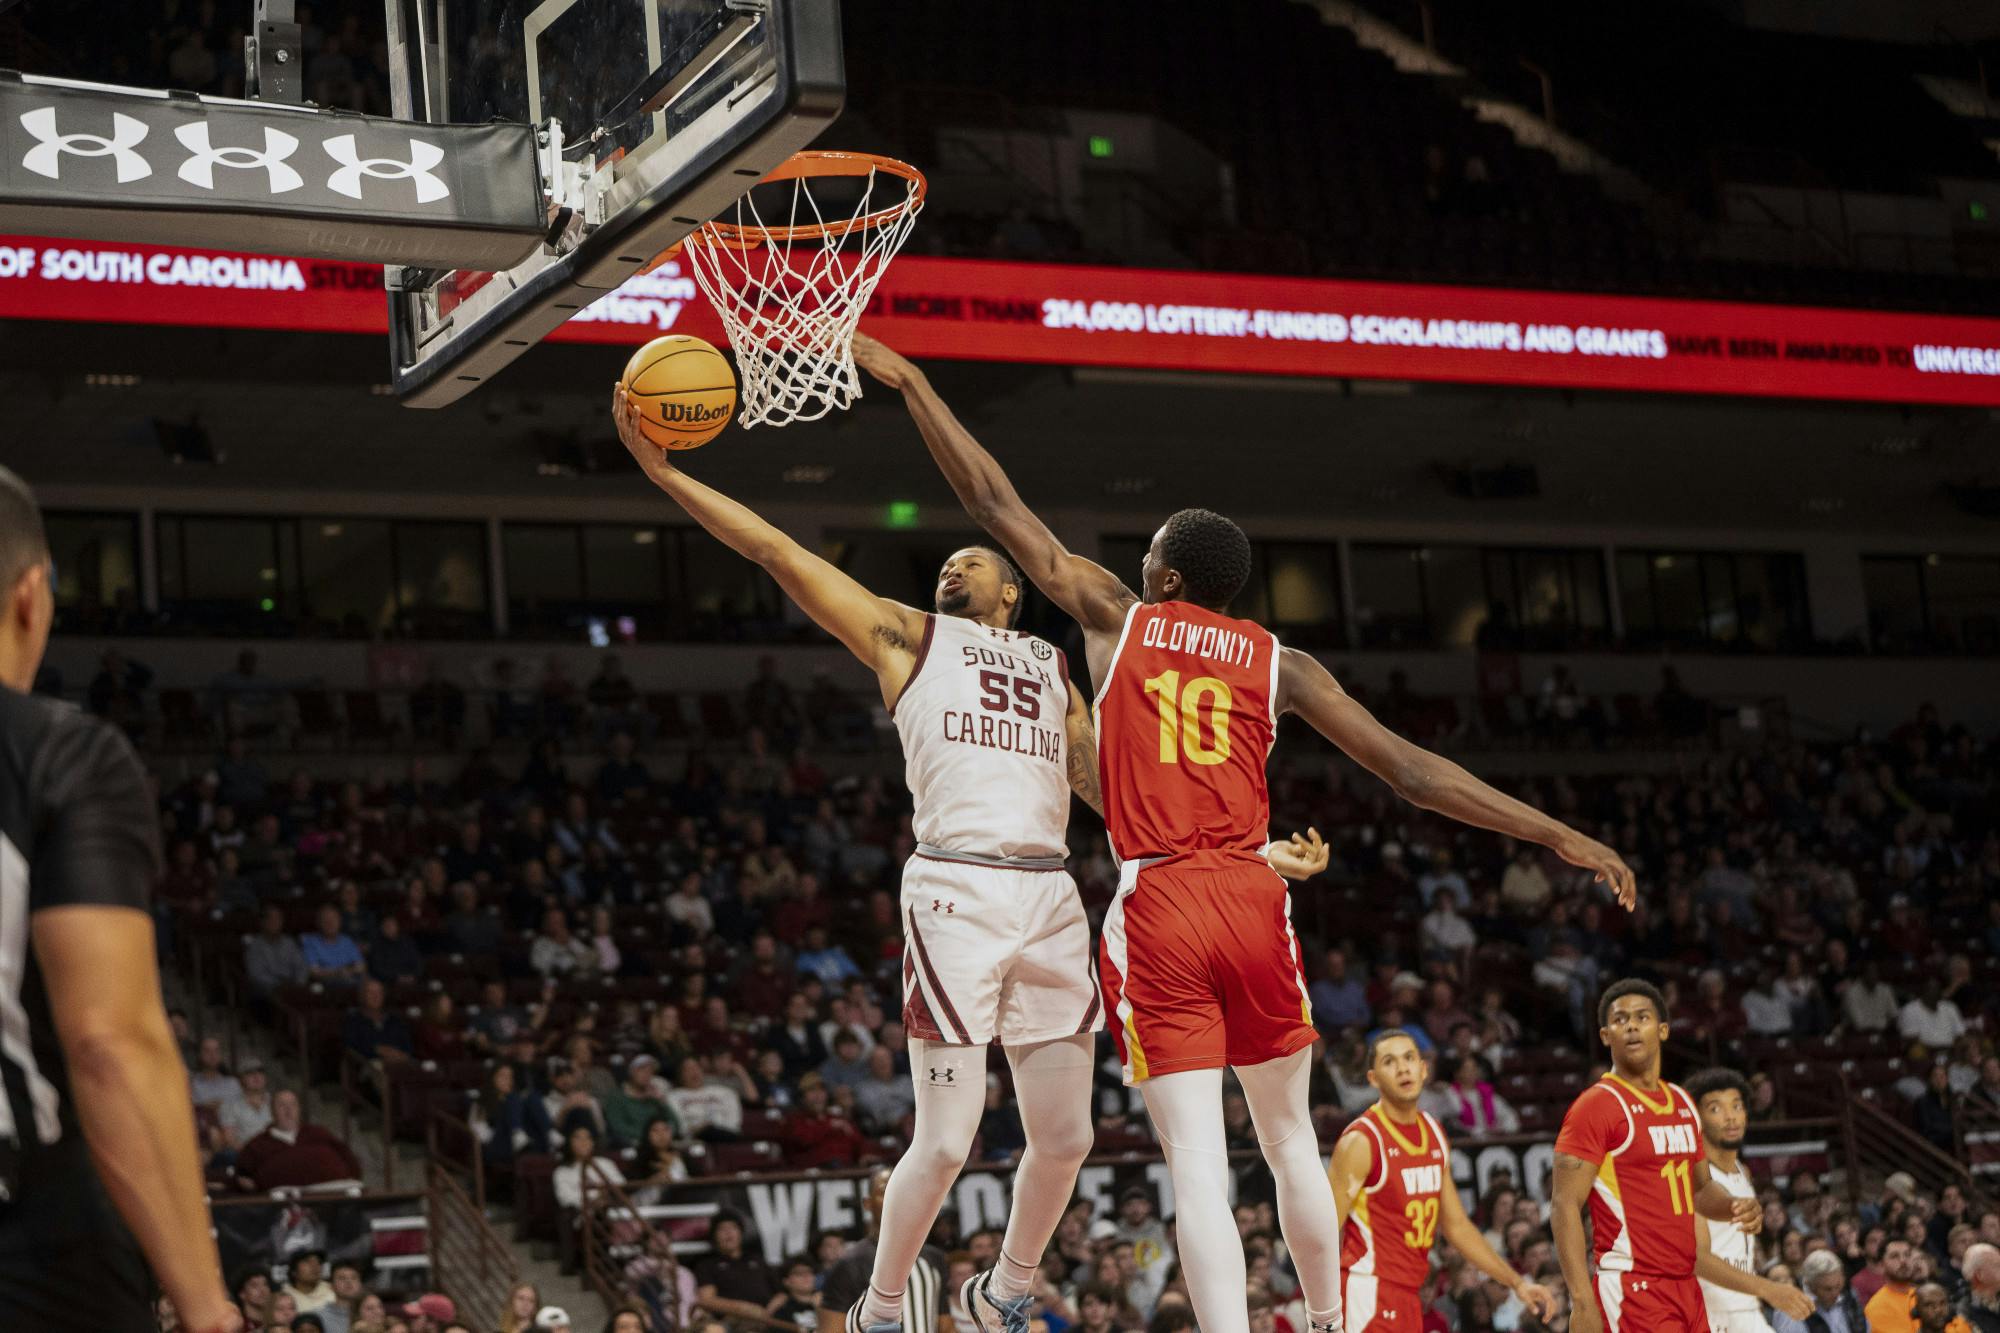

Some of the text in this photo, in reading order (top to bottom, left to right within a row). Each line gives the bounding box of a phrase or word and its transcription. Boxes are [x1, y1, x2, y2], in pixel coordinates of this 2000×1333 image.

[0, 247, 35, 278] OF
[41, 248, 144, 283] SOUTH
[146, 253, 305, 291] CAROLINA
[1144, 304, 1349, 342] LOTTERY-FUNDED
[1350, 314, 1522, 352] SCHOLARSHIPS
[1523, 323, 1574, 354] AND
[1575, 326, 1668, 359] GRANTS
[660, 402, 730, 422] Wilson
[963, 646, 1053, 690] SOUTH
[1031, 641, 1053, 660] SEC
[1143, 617, 1254, 669] OLOWONIYI
[980, 669, 1042, 721] 55
[1144, 669, 1233, 765] 10
[944, 711, 1060, 763] CAROLINA
[1648, 1124, 1697, 1155] VMI
[1401, 1164, 1441, 1195] VMI
[1660, 1159, 1694, 1216] 11
[1404, 1197, 1439, 1248] 32
